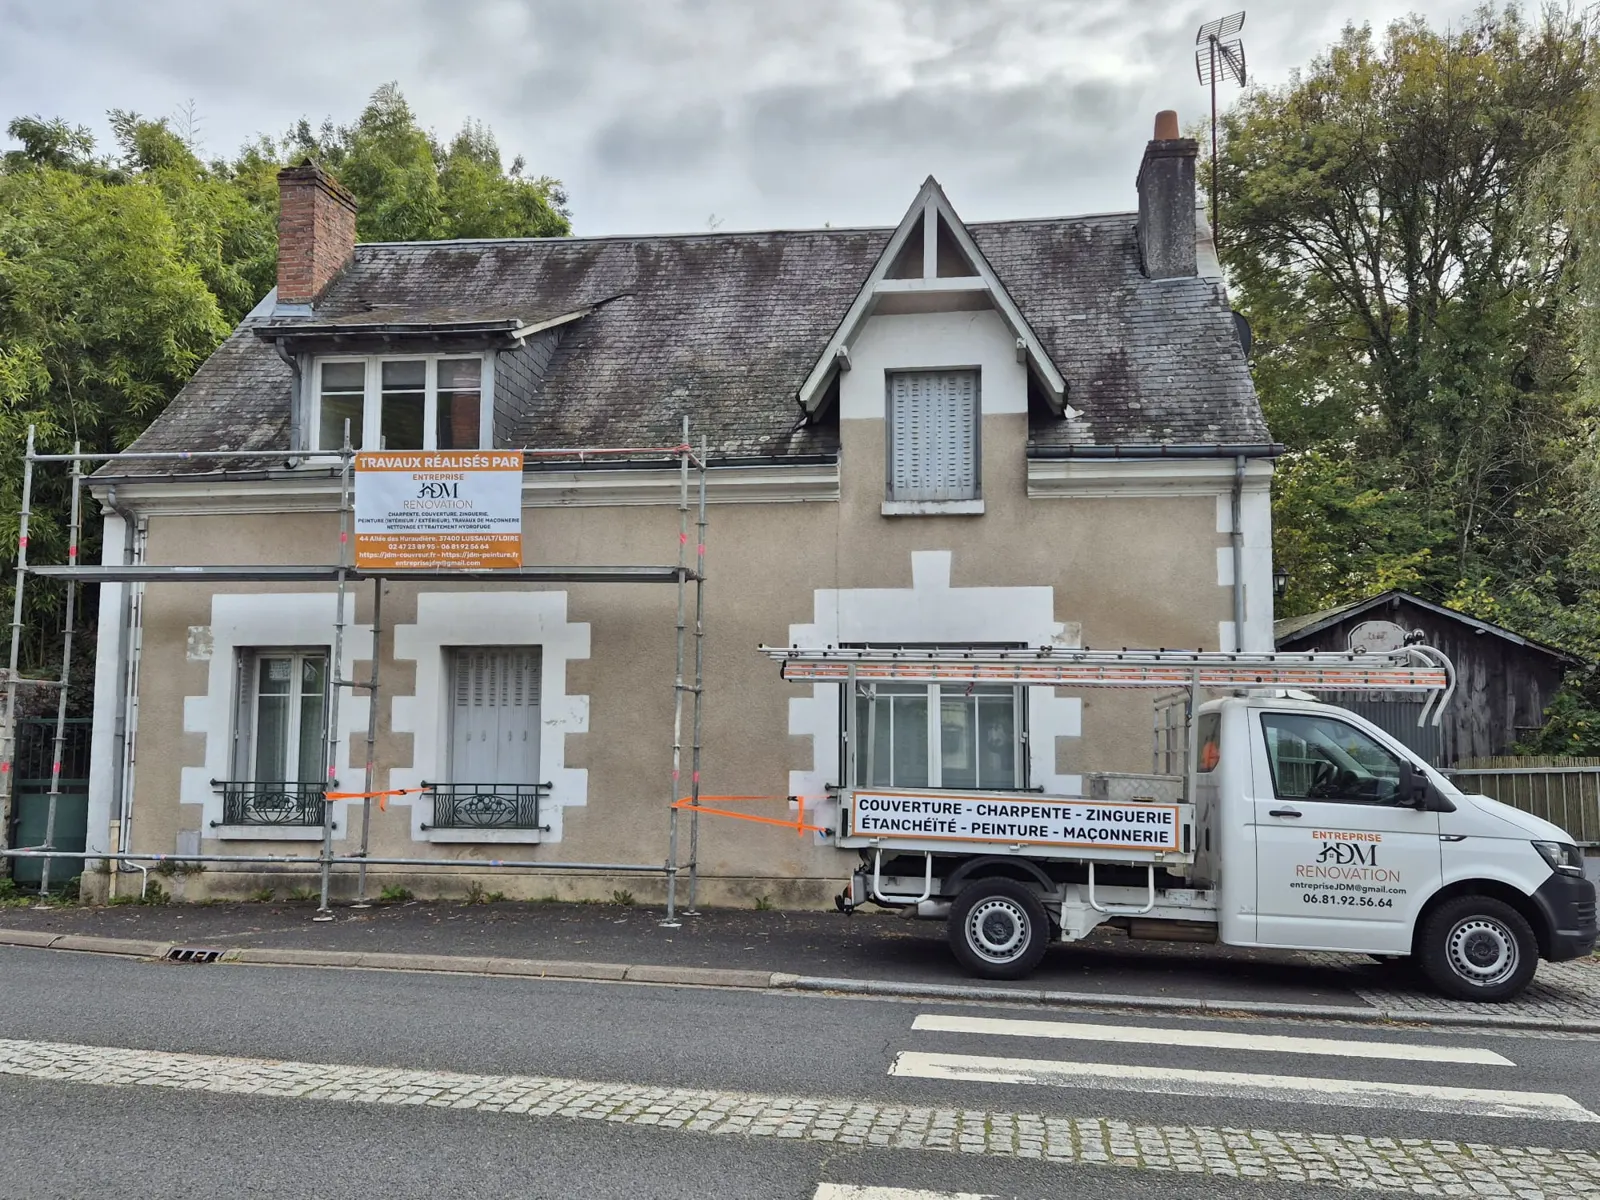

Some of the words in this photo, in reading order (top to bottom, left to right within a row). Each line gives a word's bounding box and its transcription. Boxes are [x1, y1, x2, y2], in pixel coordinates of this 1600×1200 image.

[360, 458, 421, 468] TRAVAUX
[425, 454, 489, 468] RÉALISÉS
[493, 457, 519, 467] PAR
[417, 483, 458, 498] JDM
[404, 500, 473, 509] RENOVATION
[859, 799, 962, 815] COUVERTURE
[976, 804, 1071, 820] CHARPENTE
[1086, 810, 1172, 824] ZINGUERIE
[862, 816, 956, 833] ÉTANCHÉÏTÉ
[972, 823, 1048, 837] PEINTURE
[1064, 828, 1168, 843] MAÇONNERIE
[1313, 831, 1382, 842] ENTREPRISE
[1316, 842, 1378, 866] JDM
[1296, 865, 1400, 882] RENOVATION
[1290, 882, 1406, 894] entrepriseJDM@gmail.com
[1303, 894, 1392, 908] 06.81.92.56.64
